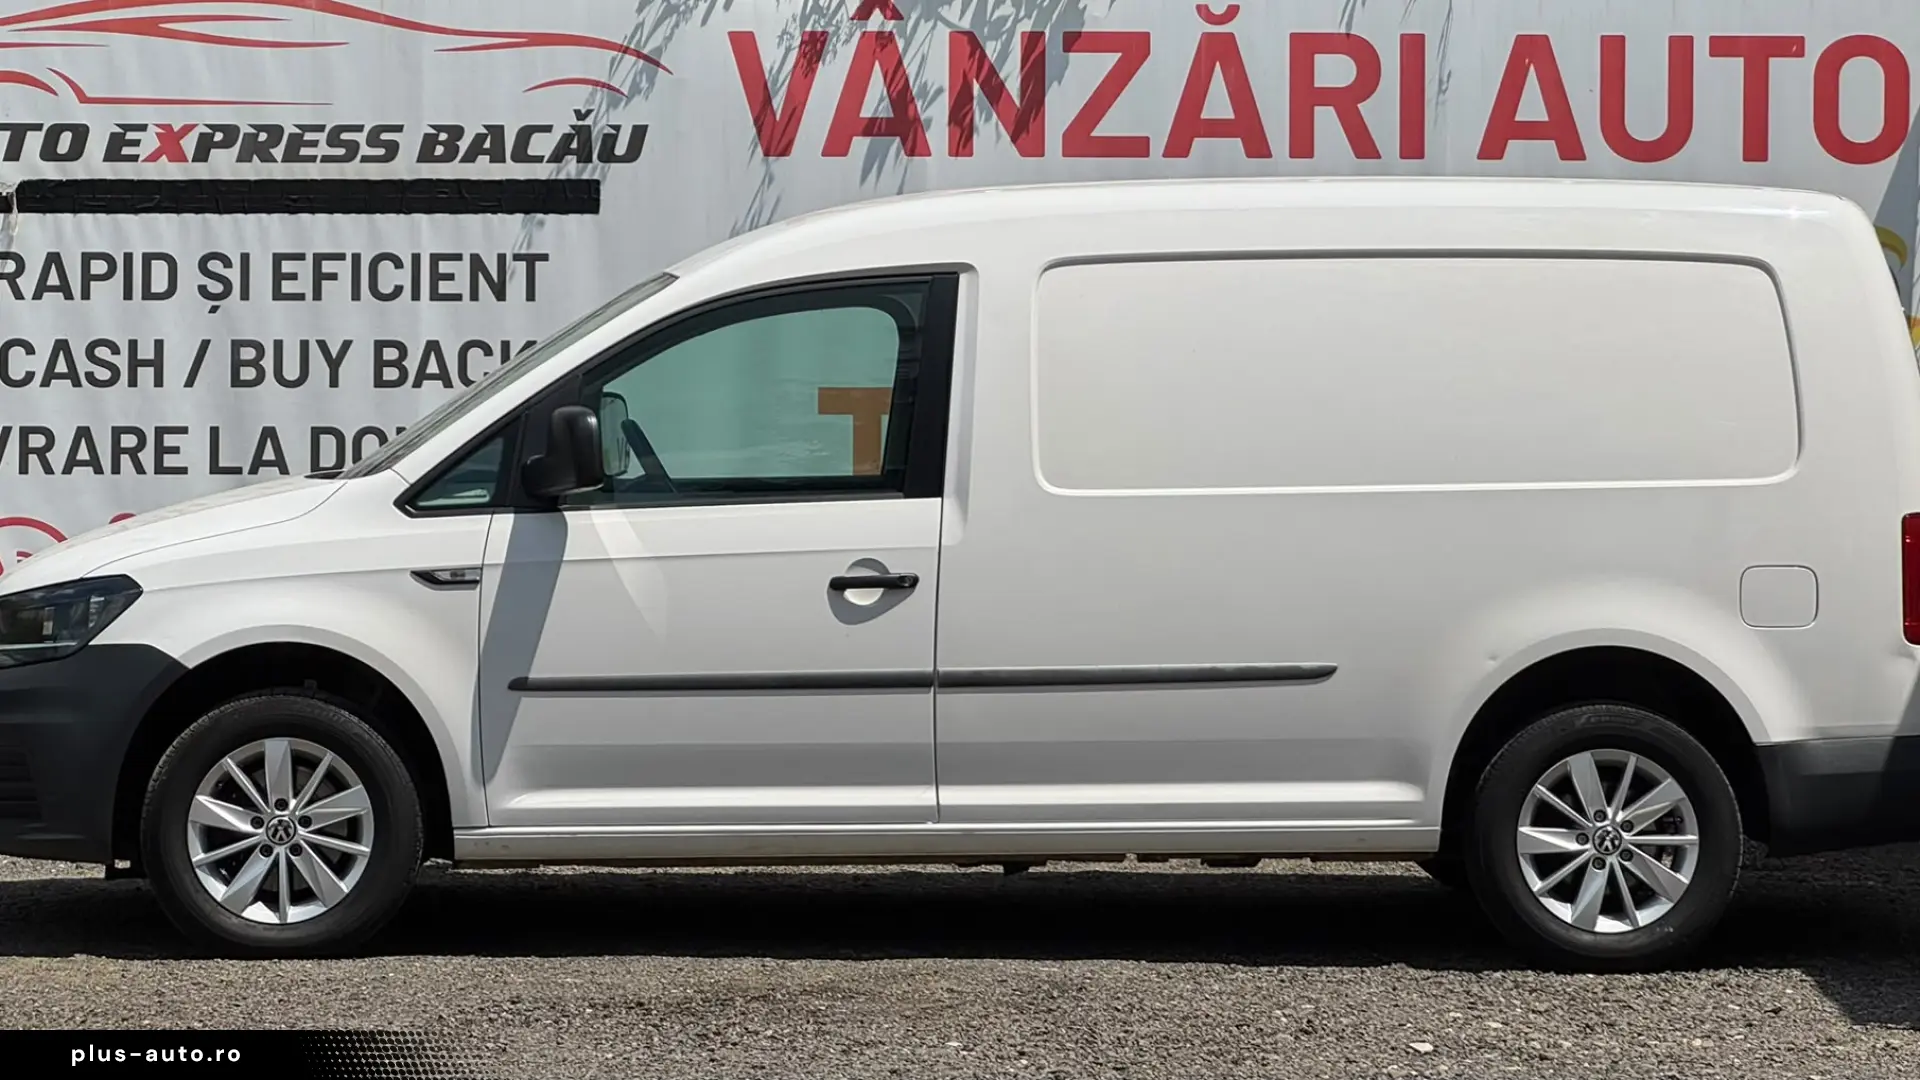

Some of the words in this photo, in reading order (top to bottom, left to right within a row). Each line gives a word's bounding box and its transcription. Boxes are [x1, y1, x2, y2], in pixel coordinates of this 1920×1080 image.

[728, 0, 1426, 160] VÂNZĂRI
[1478, 34, 1911, 165] AUTO
[102, 123, 405, 164] EXPRESS
[415, 108, 649, 164] BACĂU
[0, 251, 178, 301] RAPID
[197, 251, 250, 314] ȘI
[271, 252, 550, 302] EFICIENT
[0, 338, 164, 388] CASH
[183, 338, 212, 388] /
[230, 339, 353, 389] BUY
[0, 425, 189, 475] RARE
[209, 425, 290, 476] LA
[310, 425, 407, 475] DO
